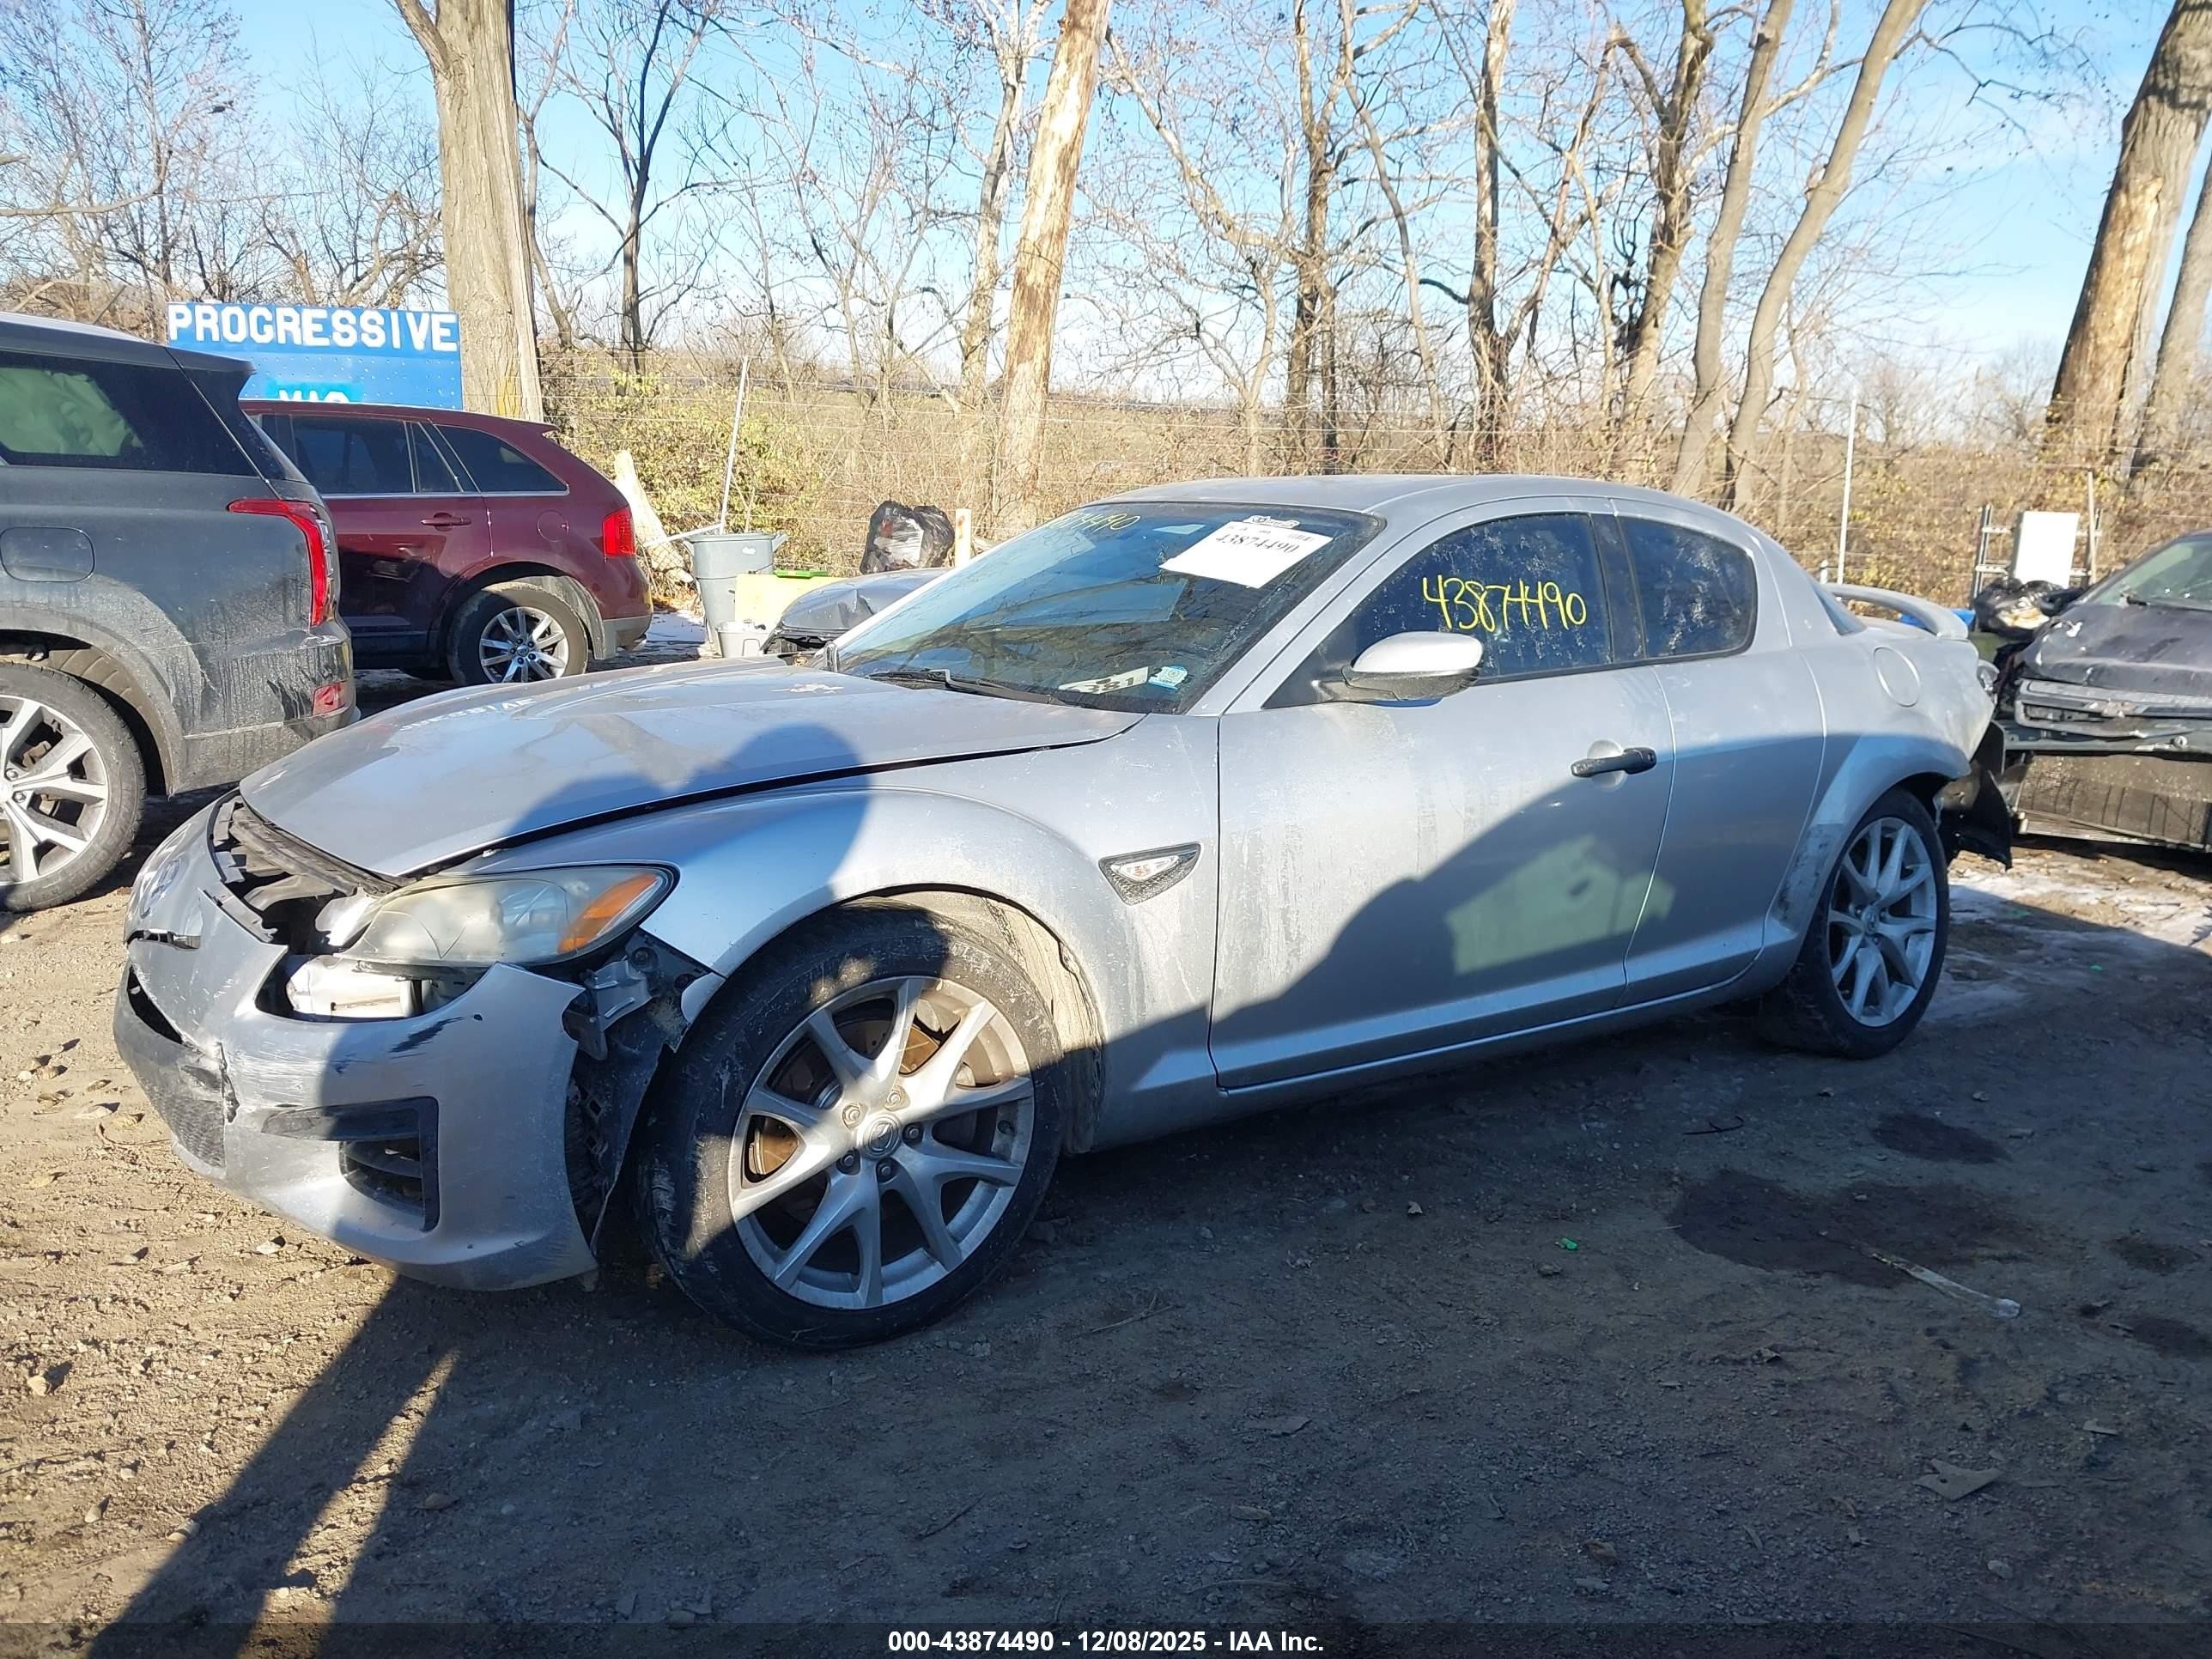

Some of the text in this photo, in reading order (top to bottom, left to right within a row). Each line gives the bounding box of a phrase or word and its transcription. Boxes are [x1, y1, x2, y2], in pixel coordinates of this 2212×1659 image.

[168, 305, 458, 351] PROGRESSIVE
[1216, 533, 1301, 554] 43874490
[1422, 574, 1587, 632] 43874490
